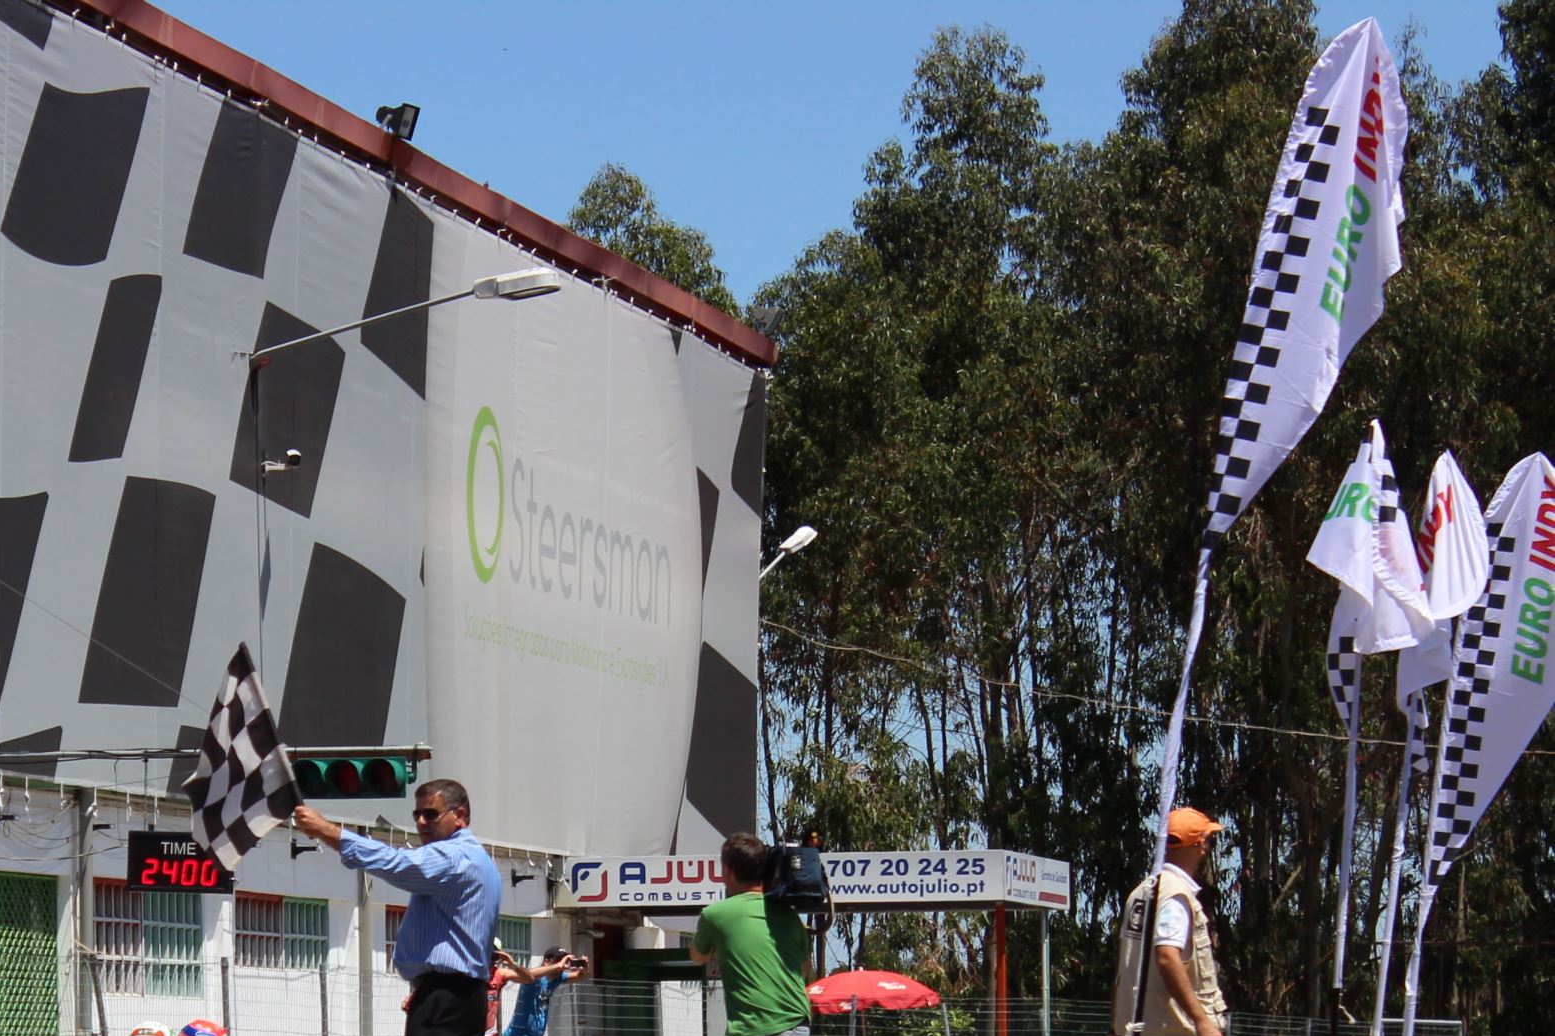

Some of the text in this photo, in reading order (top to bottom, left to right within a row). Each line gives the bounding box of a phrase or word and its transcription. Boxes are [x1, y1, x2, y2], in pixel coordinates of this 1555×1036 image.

[1353, 56, 1385, 183] IND
[1319, 183, 1371, 322] EURO
[509, 457, 671, 628] Steersman
[1511, 576, 1555, 685] EURO
[161, 841, 197, 856] TIME
[620, 857, 986, 885] AJÚL 707 20 24 25
[620, 878, 986, 902] COMBUSTÍ www.autojulio.pt
